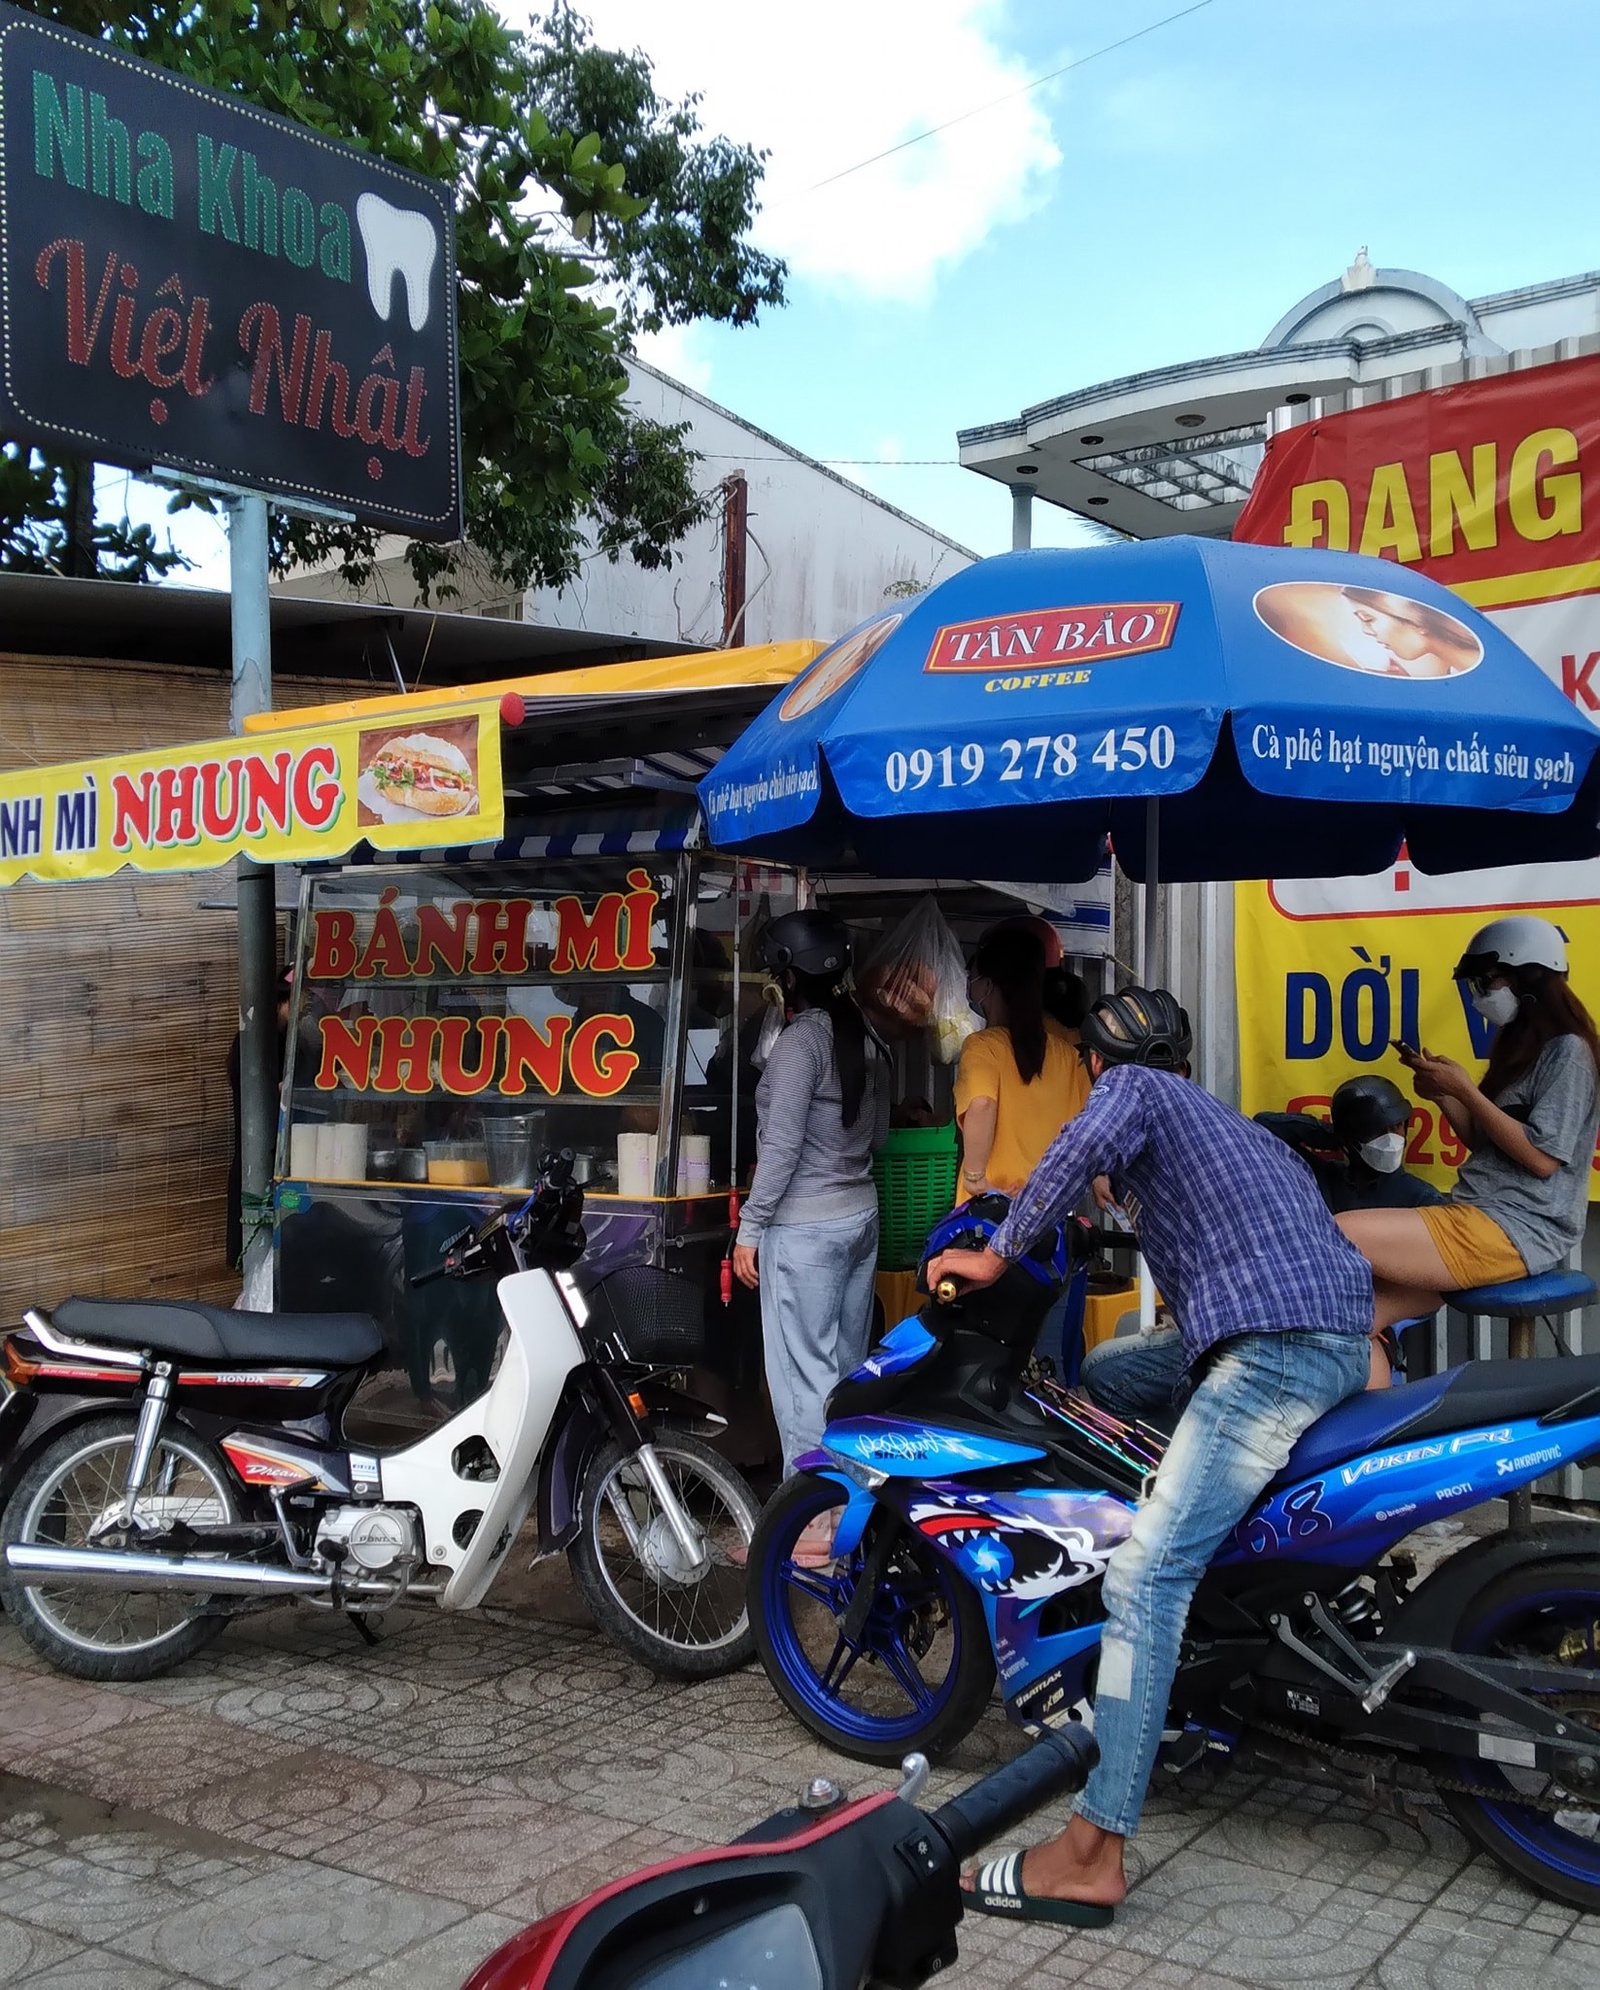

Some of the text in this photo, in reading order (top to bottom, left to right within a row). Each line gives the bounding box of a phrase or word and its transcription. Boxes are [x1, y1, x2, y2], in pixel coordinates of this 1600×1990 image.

[32, 70, 352, 283] Nha Khoa
[36, 239, 431, 481] Việt Nhật
[1283, 428, 1582, 563] ĐANG
[1053, 610, 1156, 652] BẢO
[984, 670, 1092, 693] COFFEE
[885, 725, 1175, 793] 0919 278 450
[1252, 724, 1574, 790] Cà phê hạt nguyên chất siêu sạch
[55, 775, 97, 853] MÌ
[111, 746, 341, 850] NHUNG
[308, 886, 532, 979] BÁNH
[549, 868, 659, 974] MÌ
[1285, 946, 1421, 1062] DỜI
[315, 1014, 639, 1097] NHUNG
[217, 1375, 265, 1384] HONDA
[245, 1464, 304, 1479] Dream
[1435, 1482, 1473, 1500] PROTI
[1386, 1503, 1417, 1518] brembo
[985, 1895, 1022, 1909] adidas
